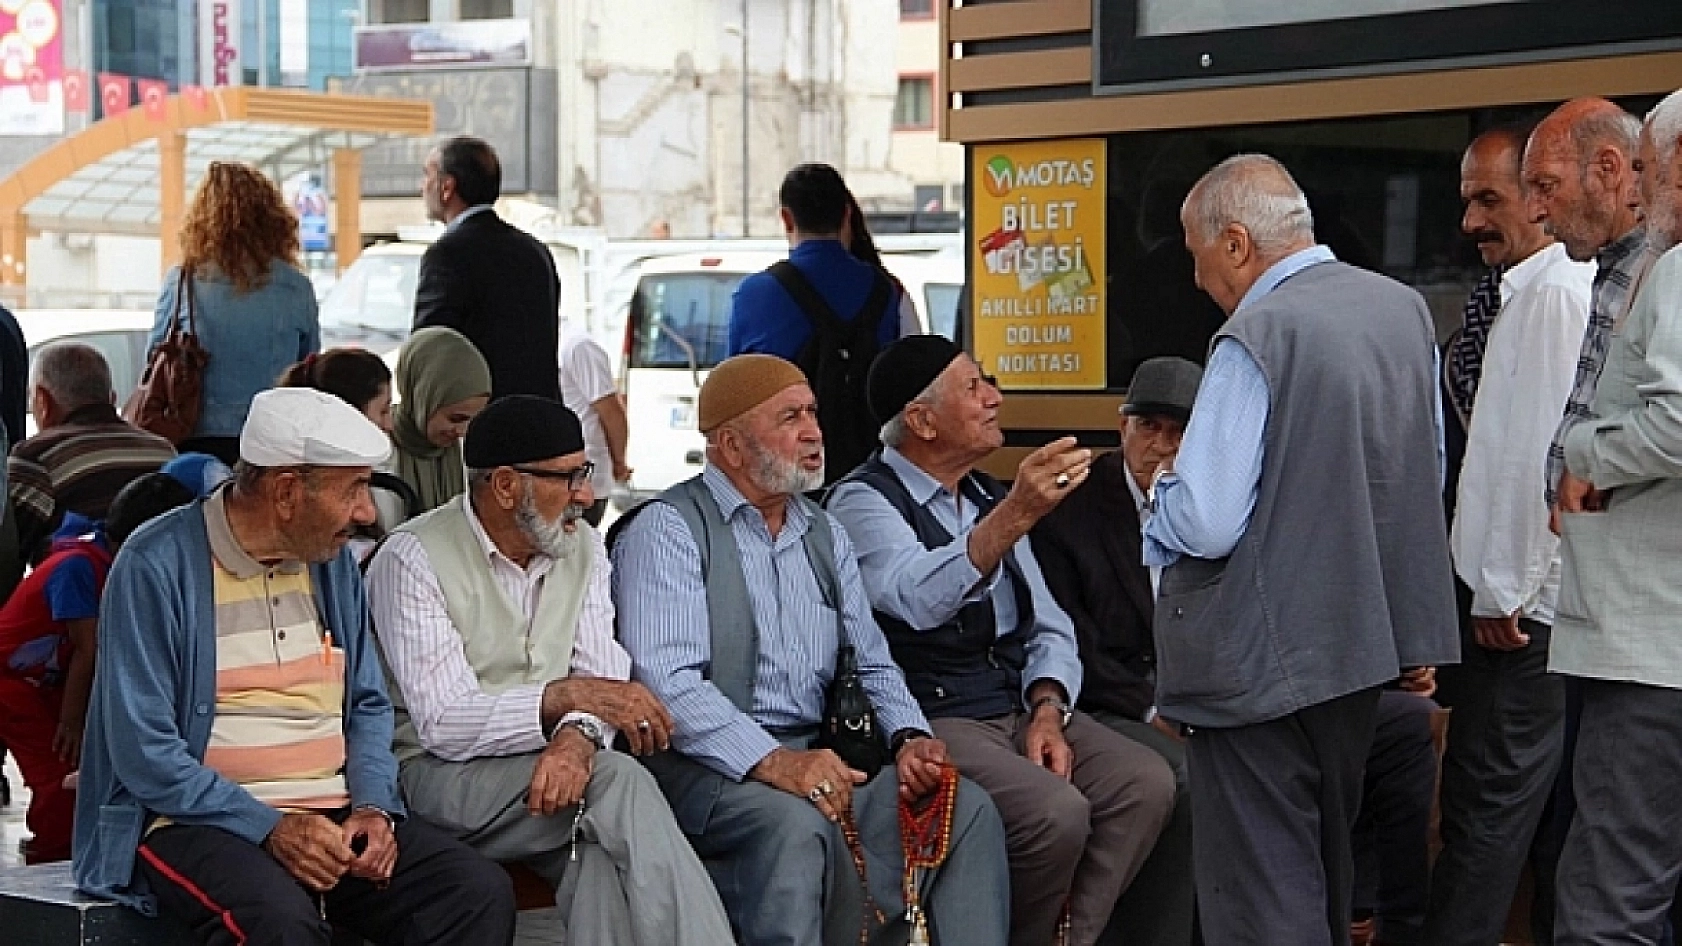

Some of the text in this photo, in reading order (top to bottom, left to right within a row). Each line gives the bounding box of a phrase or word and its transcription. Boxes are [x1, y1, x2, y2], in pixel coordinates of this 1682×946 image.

[1015, 159, 1094, 189] MOTAŞ
[1003, 196, 1078, 231] BİLET
[981, 295, 1098, 317] AKILLI KART
[1006, 325, 1072, 344] DOLUM
[998, 354, 1079, 372] NOKTASI
